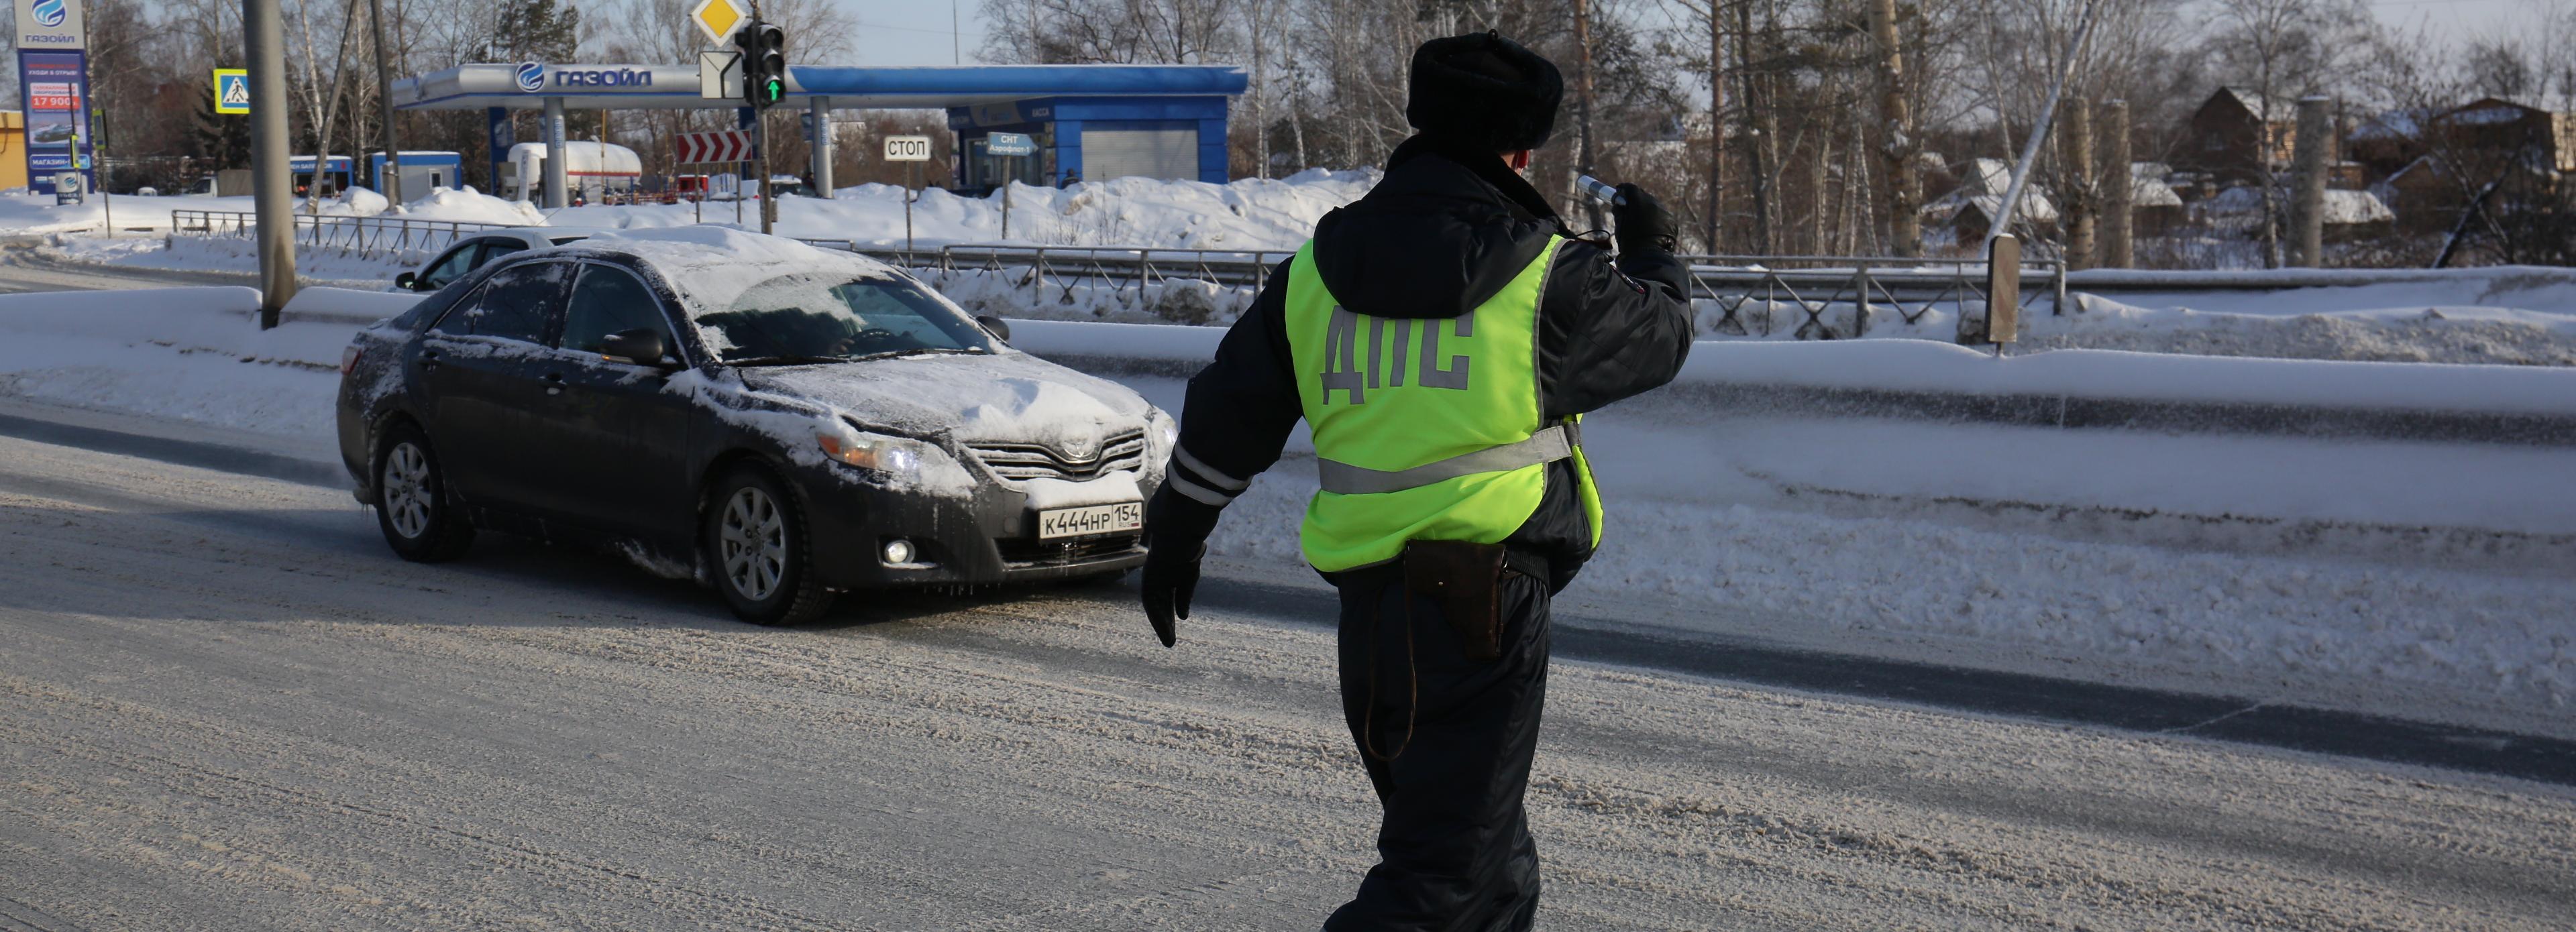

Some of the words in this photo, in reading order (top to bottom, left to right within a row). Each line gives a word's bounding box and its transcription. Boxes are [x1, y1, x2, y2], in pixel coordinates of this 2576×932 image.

[25, 34, 75, 43] ГАЗОЙЛ
[555, 68, 652, 86] ГАЗОЙЛ
[34, 97, 47, 106] 17
[50, 97, 70, 106] 900
[1001, 135, 1018, 143] СНТ
[888, 140, 926, 156] СТОП
[989, 144, 1030, 154] Аэрофлот-1
[1320, 305, 1474, 405] ДПС
[1045, 510, 1111, 535] К444НР
[1114, 504, 1140, 522] 154
